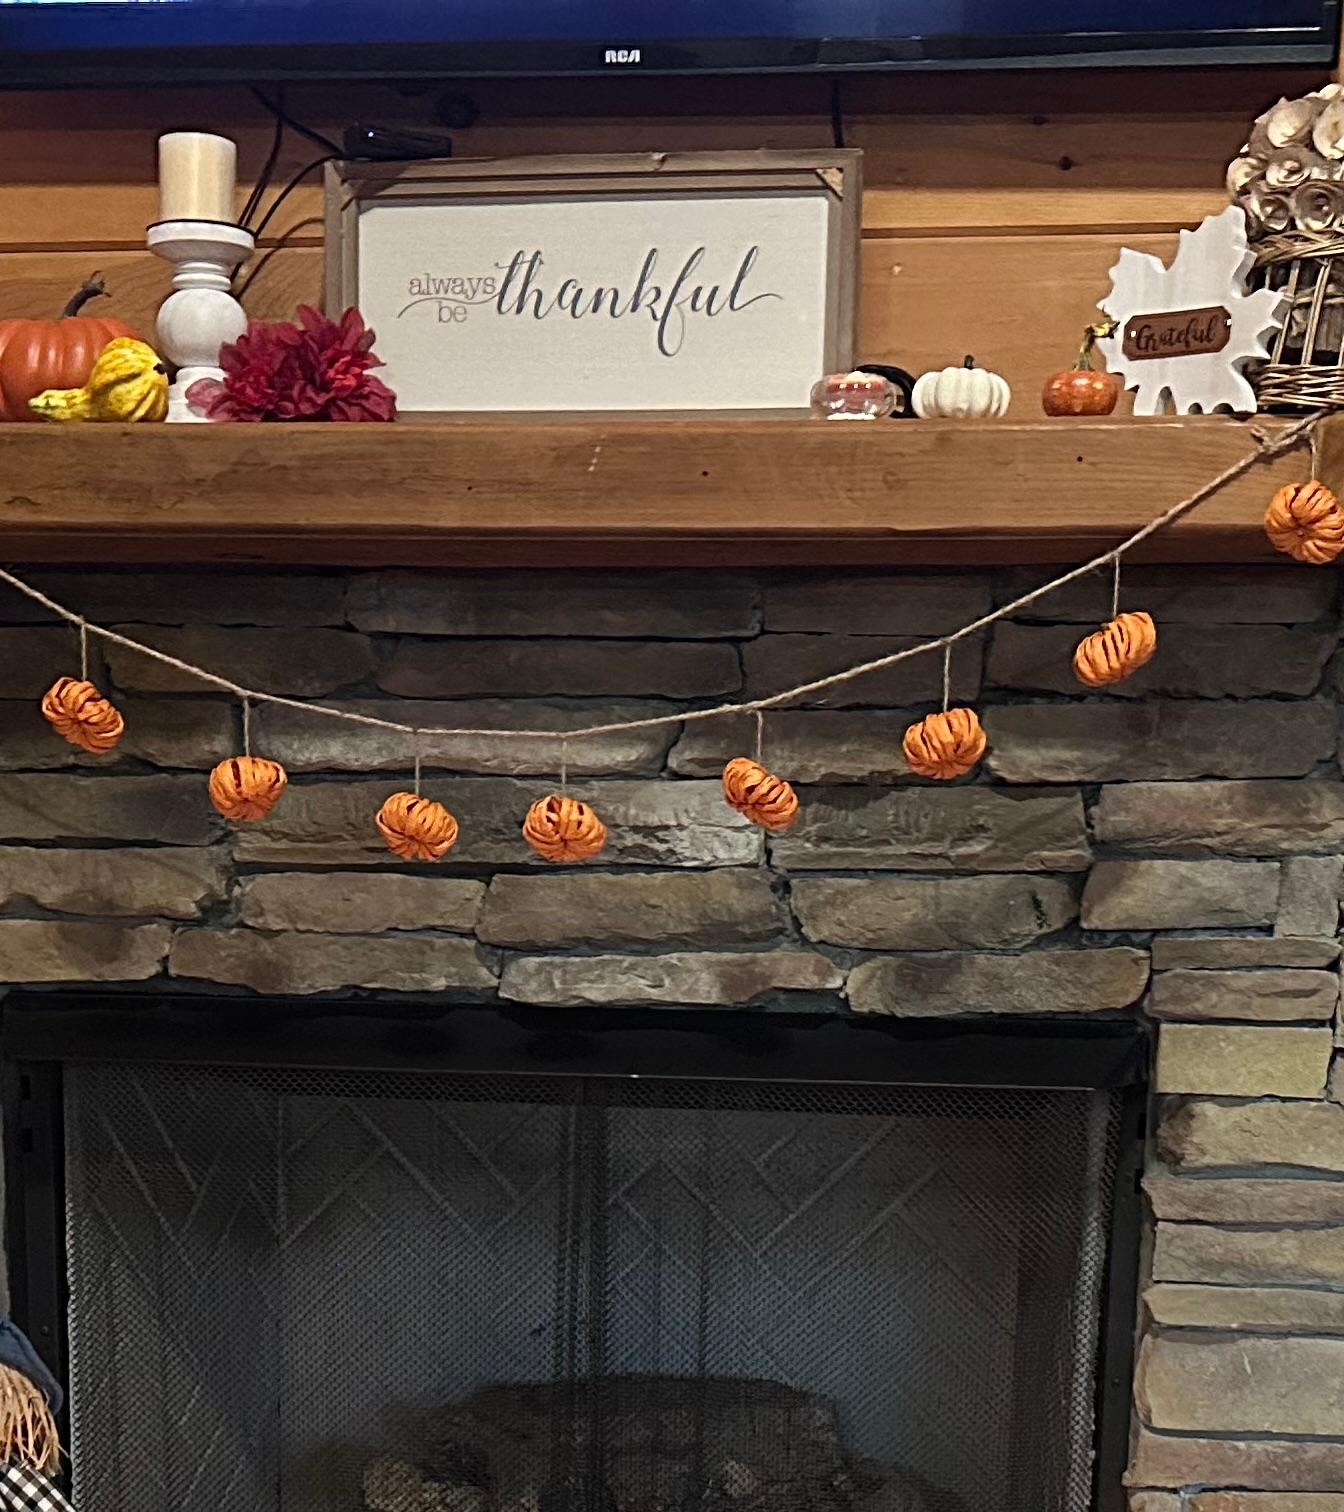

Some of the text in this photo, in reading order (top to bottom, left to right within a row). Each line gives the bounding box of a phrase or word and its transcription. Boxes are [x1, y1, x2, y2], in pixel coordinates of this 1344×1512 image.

[605, 49, 641, 63] RCA
[408, 271, 497, 301] always
[494, 245, 784, 357] thankful
[437, 299, 468, 324] be
[1136, 315, 1220, 352] Grateful
